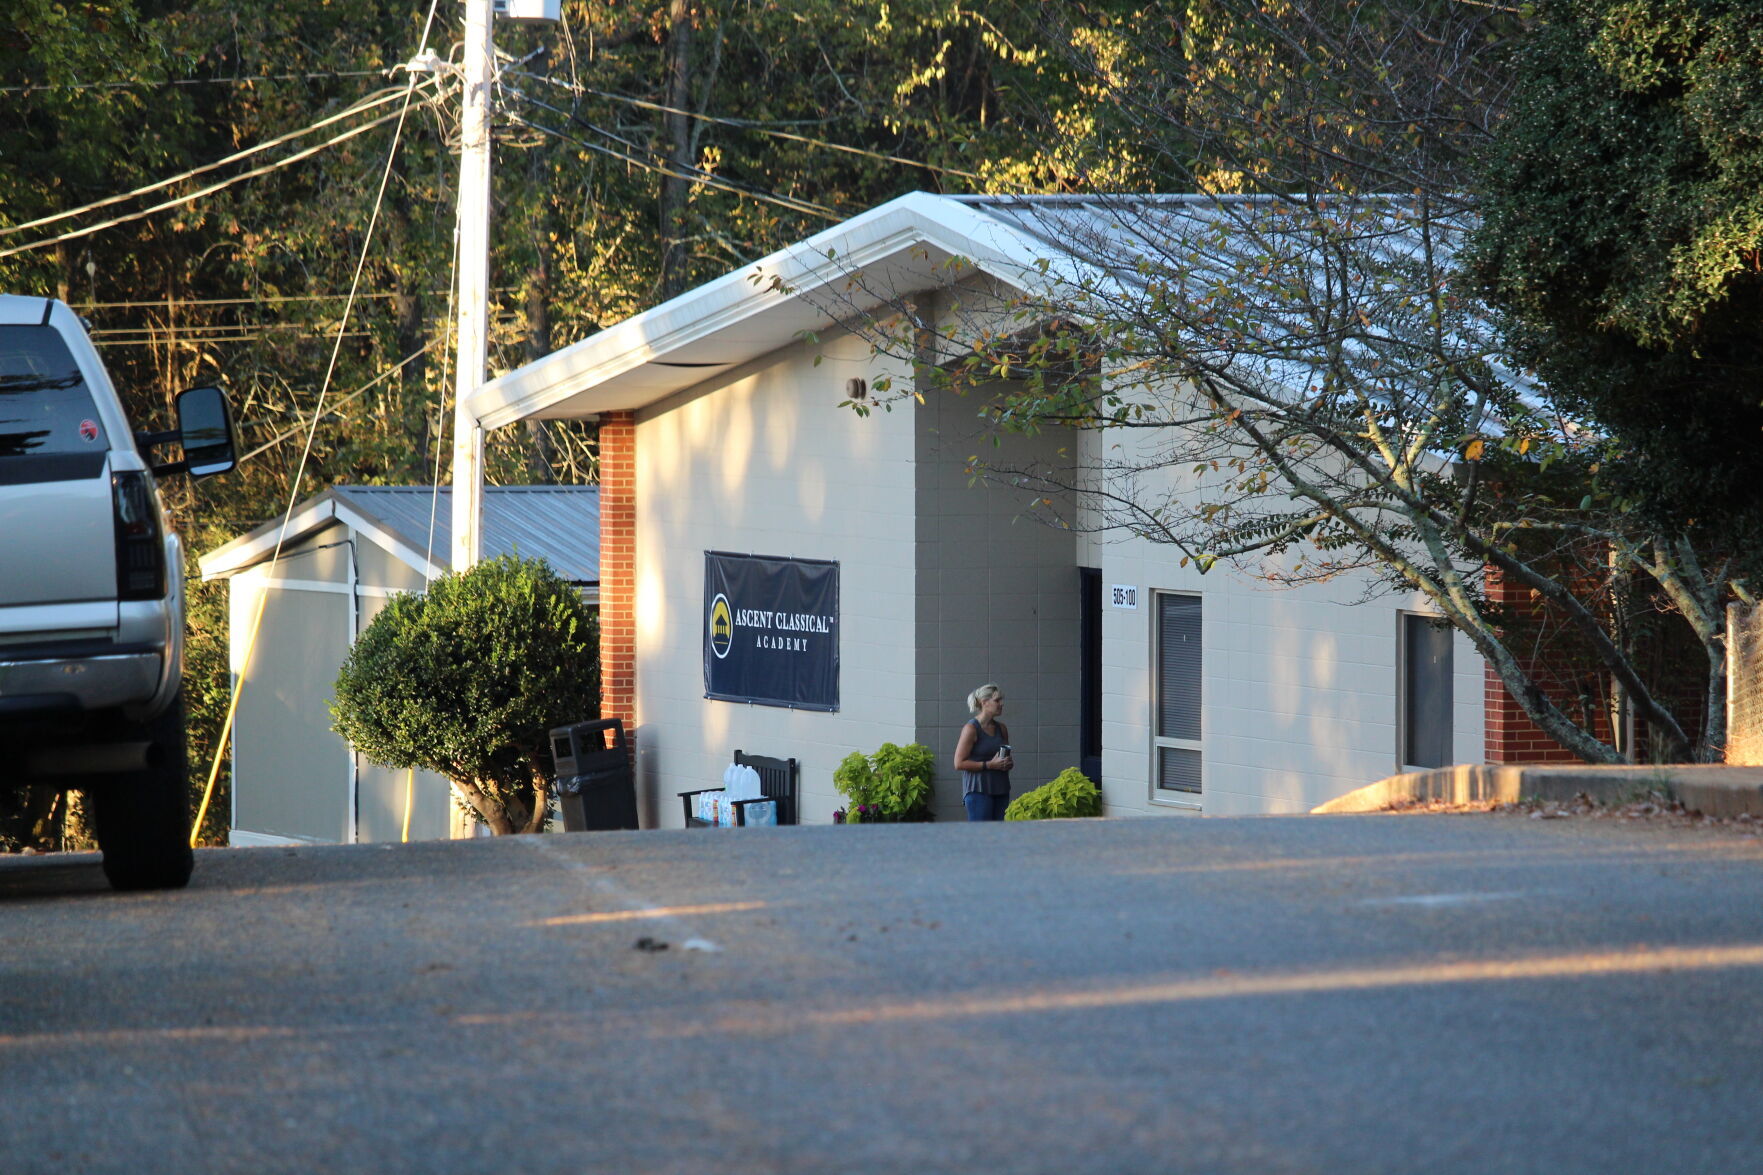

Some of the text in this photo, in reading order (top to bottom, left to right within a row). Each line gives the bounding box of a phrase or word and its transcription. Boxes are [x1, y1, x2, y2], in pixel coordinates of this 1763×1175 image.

[1113, 587, 1136, 606] 505-100
[735, 608, 830, 633] ASCENT CLASSICAL
[756, 635, 808, 652] ACADEMY
